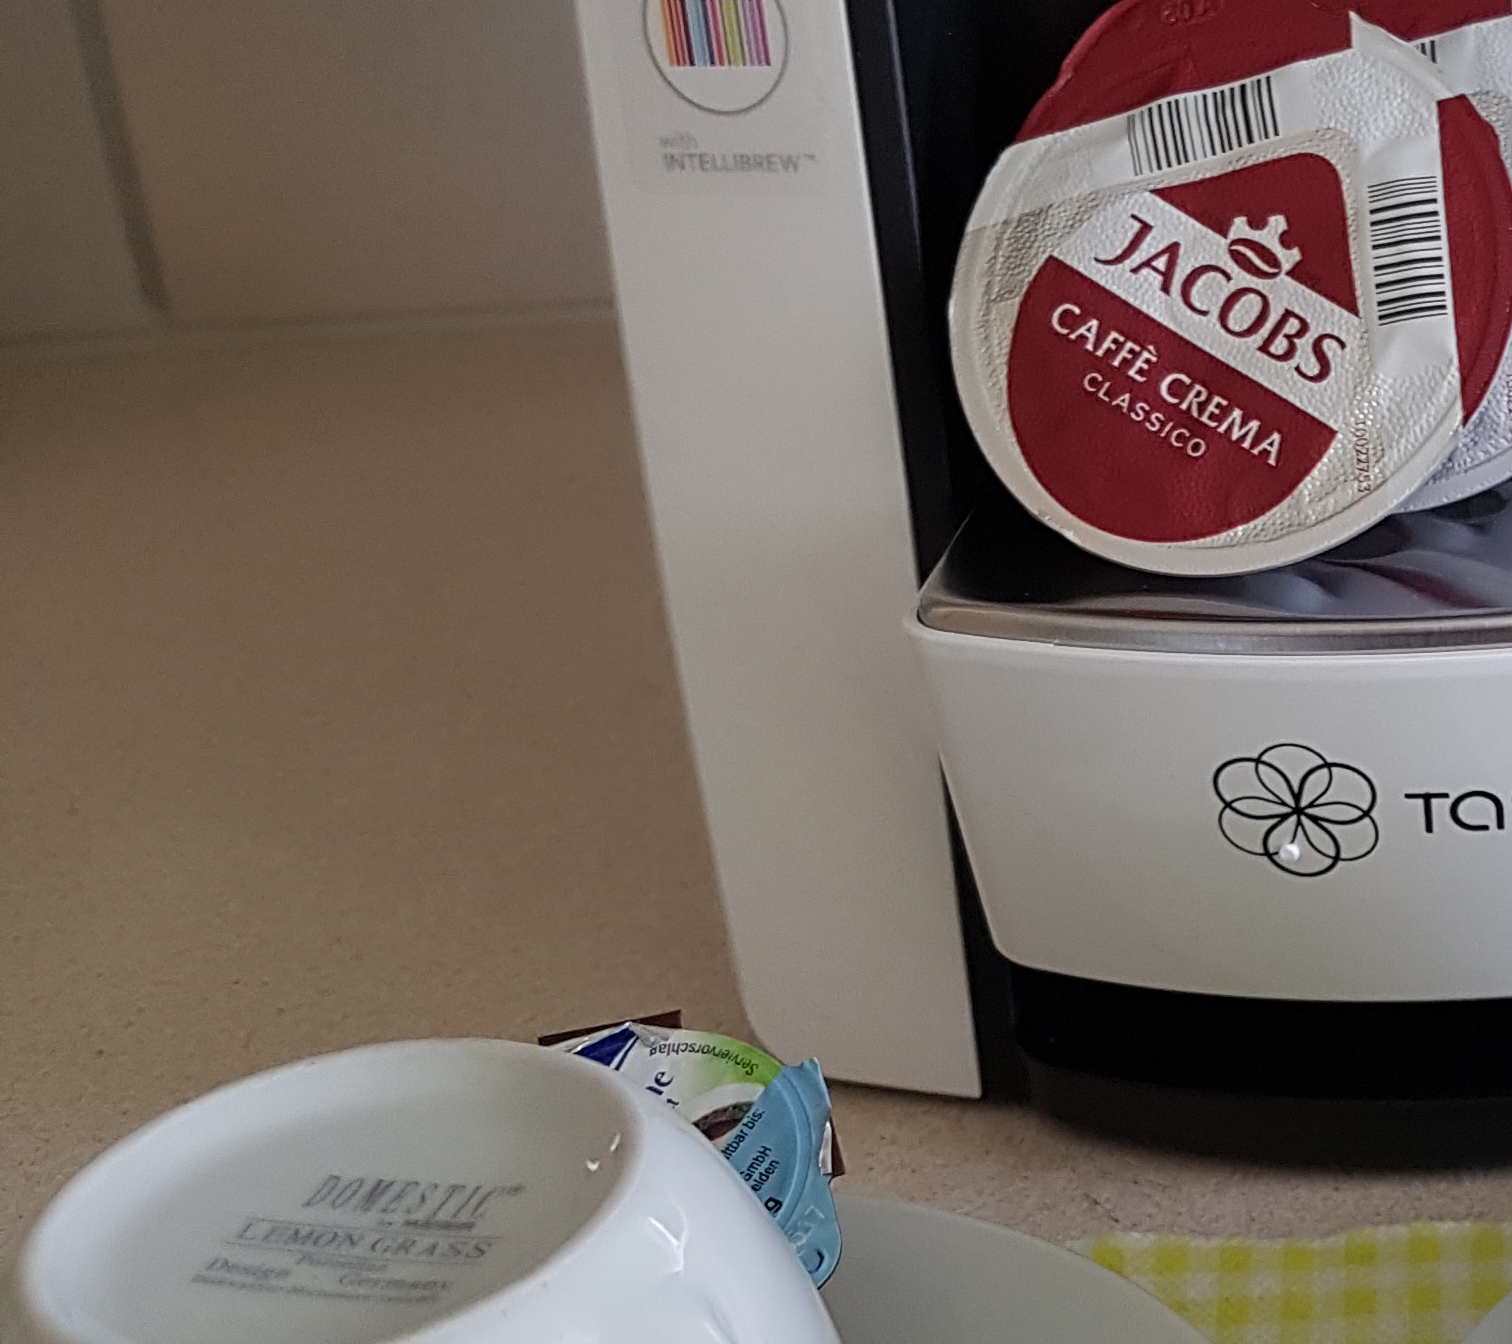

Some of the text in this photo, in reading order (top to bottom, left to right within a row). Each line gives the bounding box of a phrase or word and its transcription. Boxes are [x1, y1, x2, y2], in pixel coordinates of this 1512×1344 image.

[1093, 213, 1347, 385] JACOBS
[1049, 302, 1284, 468] CAFFÈ CREMA
[1081, 372, 1209, 459] CLASSICO
